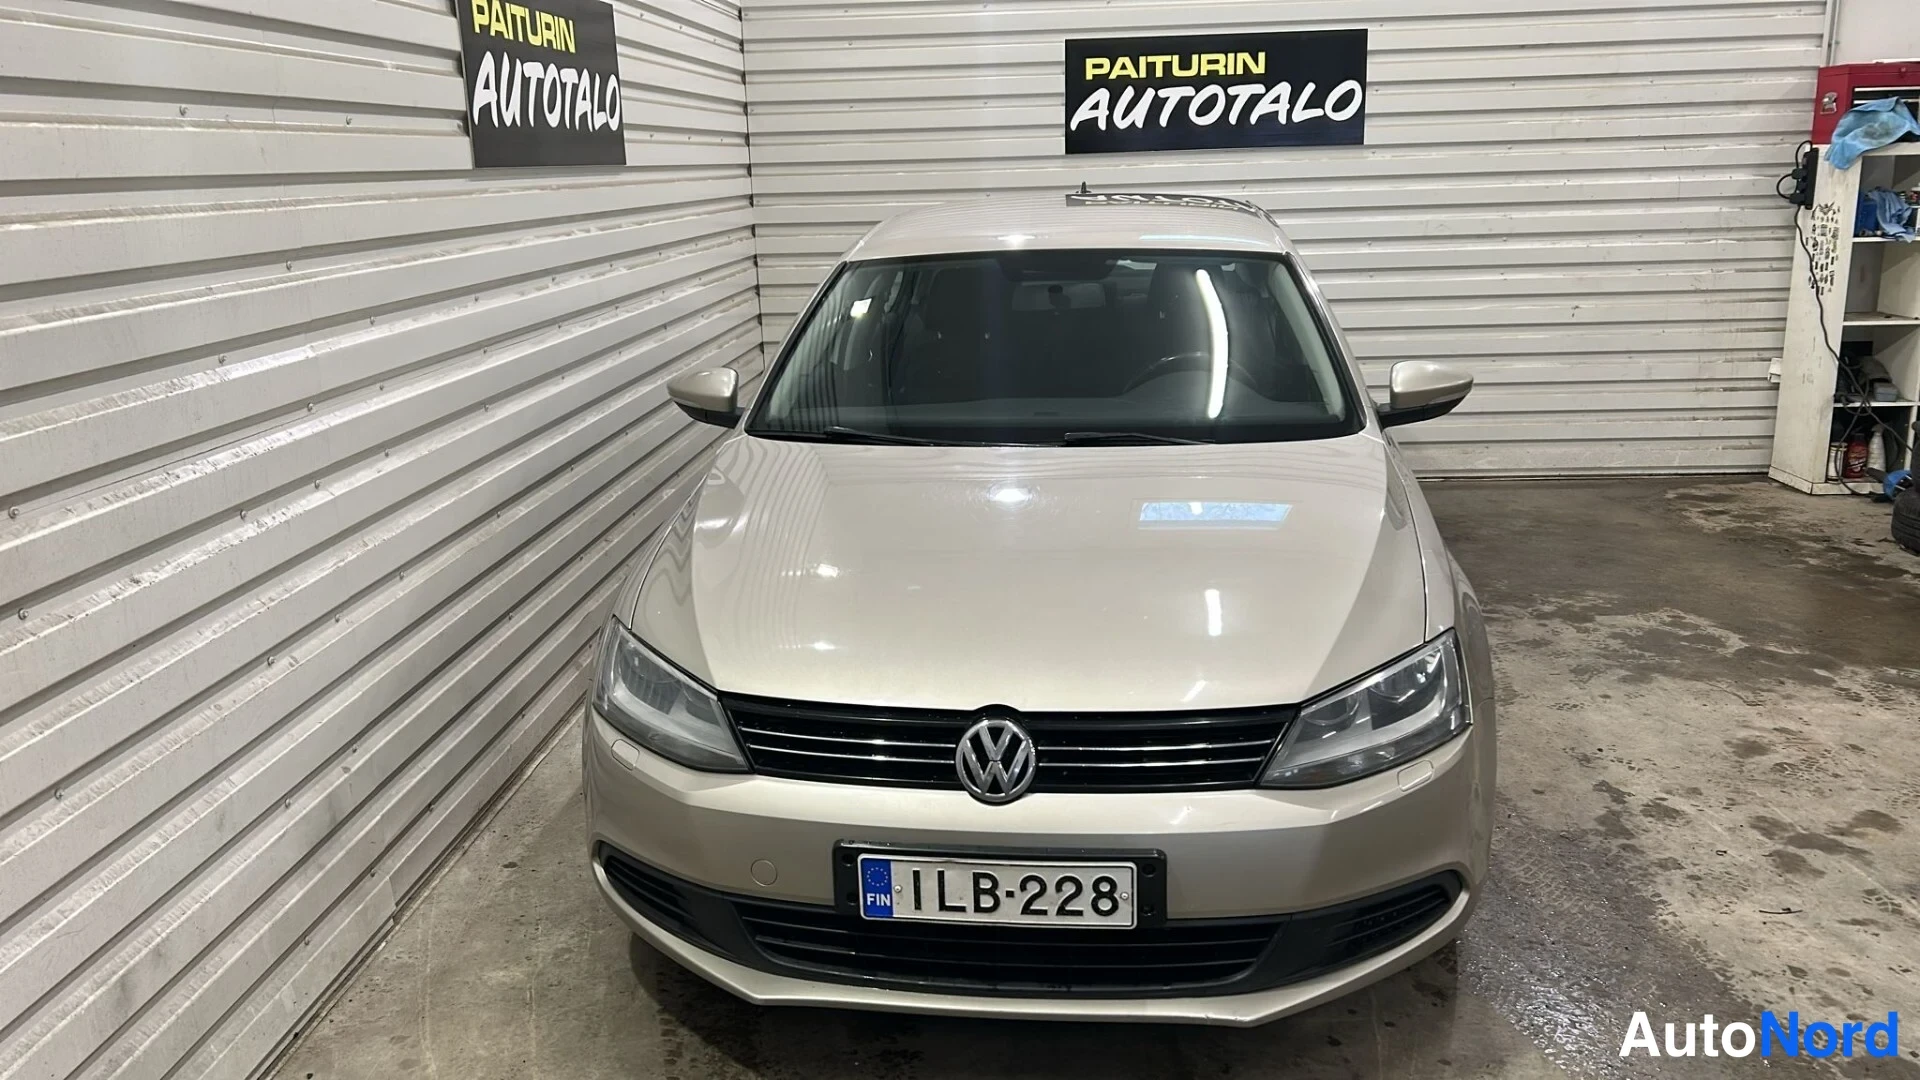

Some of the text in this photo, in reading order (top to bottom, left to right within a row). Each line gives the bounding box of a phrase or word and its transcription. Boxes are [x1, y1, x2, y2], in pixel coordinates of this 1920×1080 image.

[472, 0, 576, 53] PAITURIN
[1085, 52, 1265, 80] PAITURIN
[472, 51, 621, 132] AUTOTALO
[1070, 79, 1363, 131] AUTOTALO
[866, 893, 890, 906] FIN
[911, 868, 1119, 917] ILB-228
